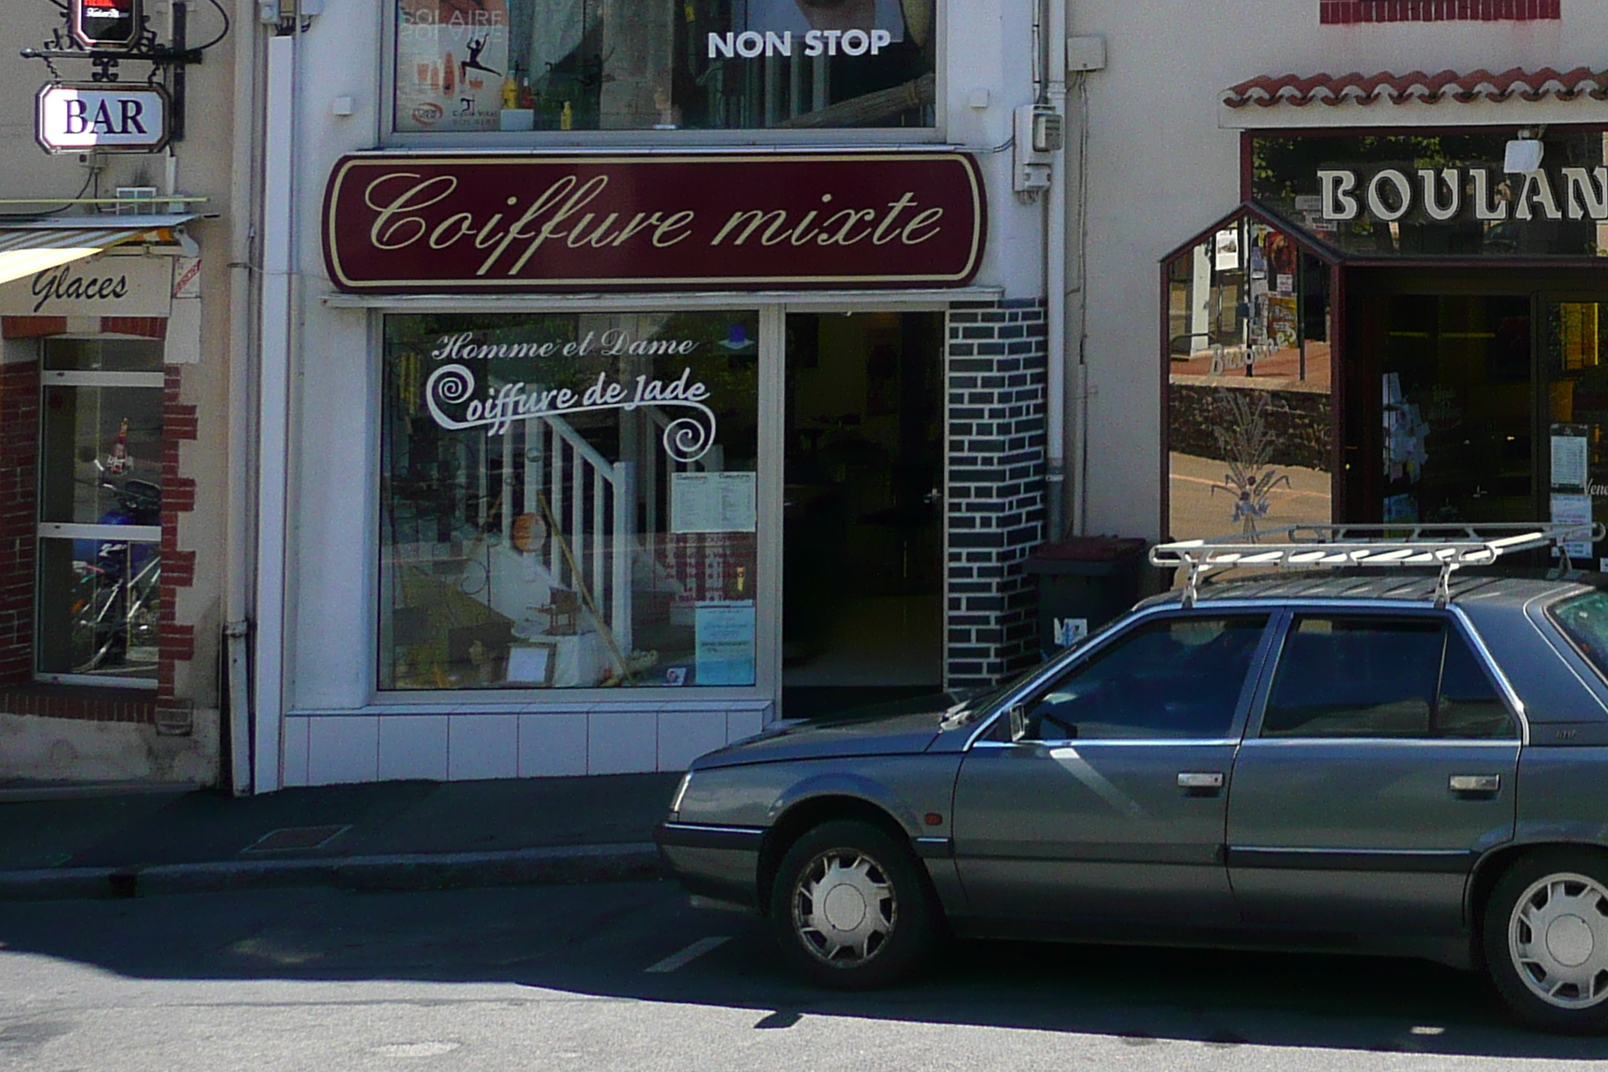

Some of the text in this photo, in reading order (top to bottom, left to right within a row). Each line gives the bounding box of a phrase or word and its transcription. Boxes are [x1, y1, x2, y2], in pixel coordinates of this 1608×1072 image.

[708, 29, 891, 58] NON STOP
[63, 97, 147, 136] BAR
[364, 172, 944, 276] Coiffure mixte
[32, 264, 129, 313] Glaces
[431, 328, 701, 360] Homme et Dame
[427, 364, 711, 437] Coiffure de Jade
